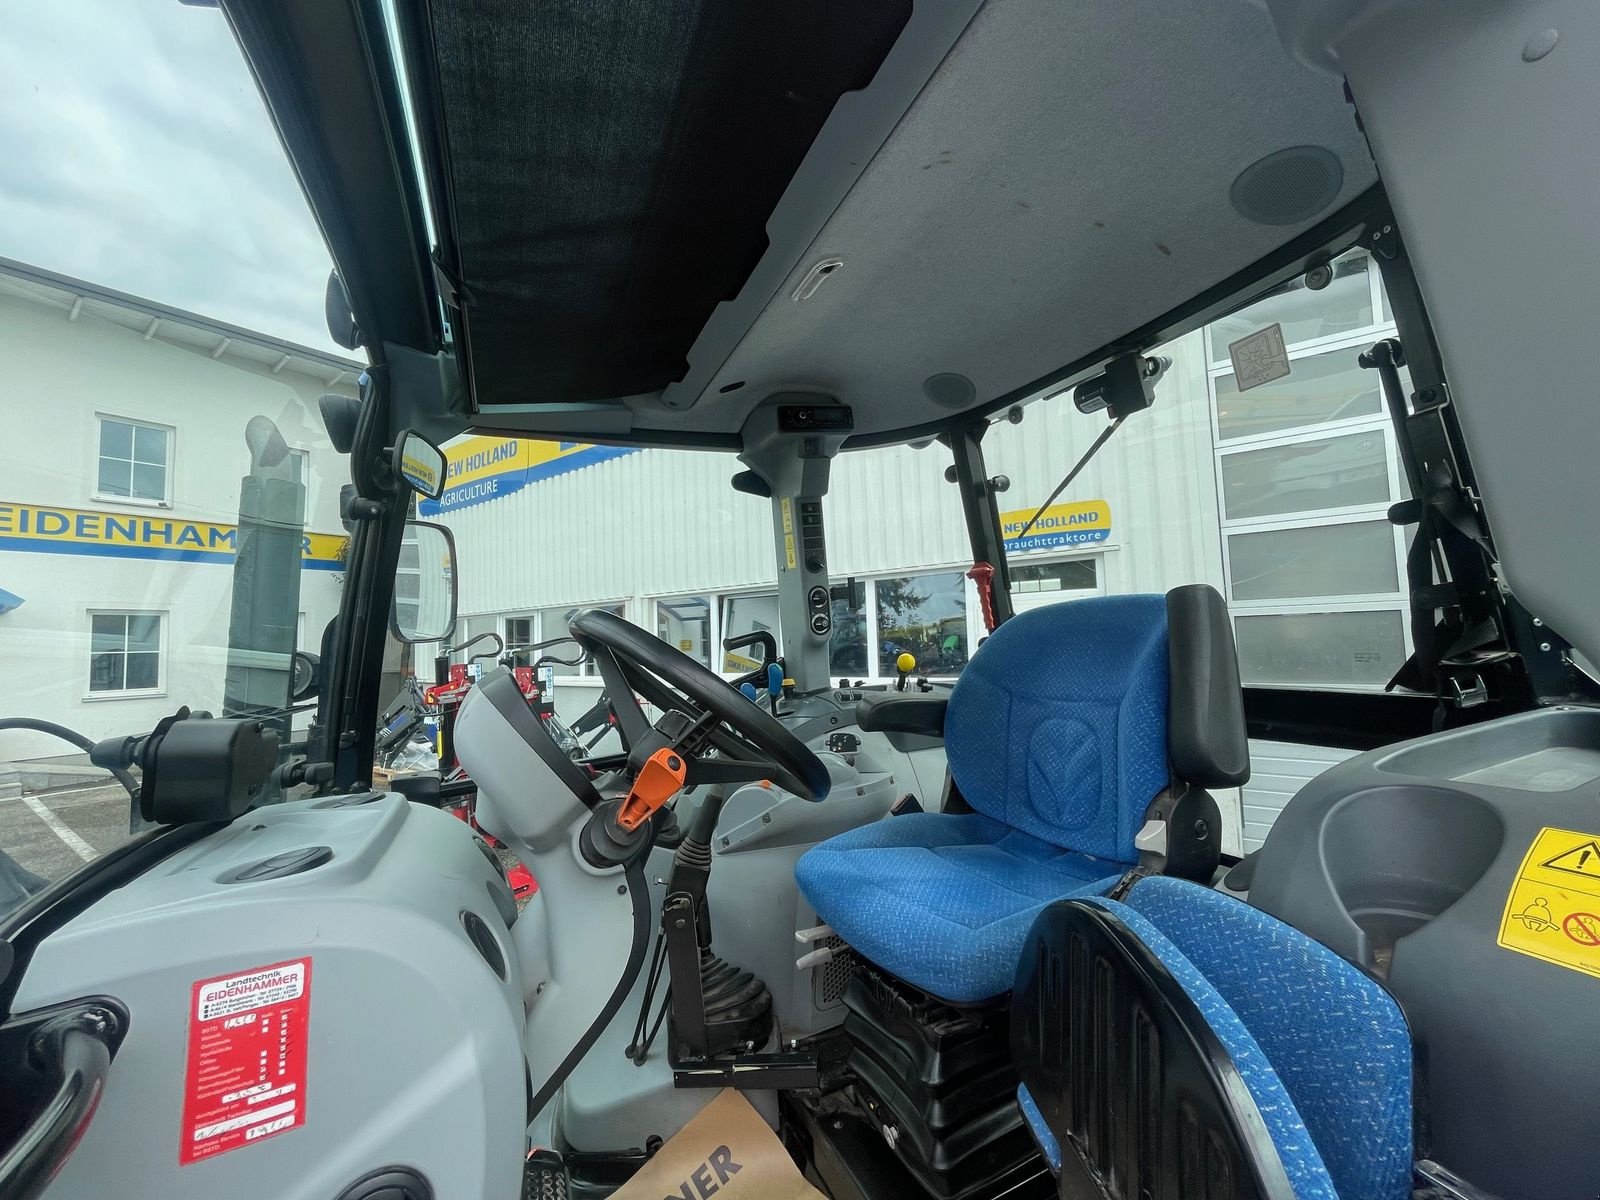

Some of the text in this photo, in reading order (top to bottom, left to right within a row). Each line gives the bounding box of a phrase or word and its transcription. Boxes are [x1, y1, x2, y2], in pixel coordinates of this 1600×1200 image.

[447, 440, 518, 479] EW HOLLAND
[440, 479, 498, 507] AGRICULTURE
[0, 506, 313, 556] EIDENHAMR
[1035, 511, 1100, 530] HOLLAND
[206, 973, 298, 1002] EIDENHAMMER
[225, 970, 282, 989] Landtechnik
